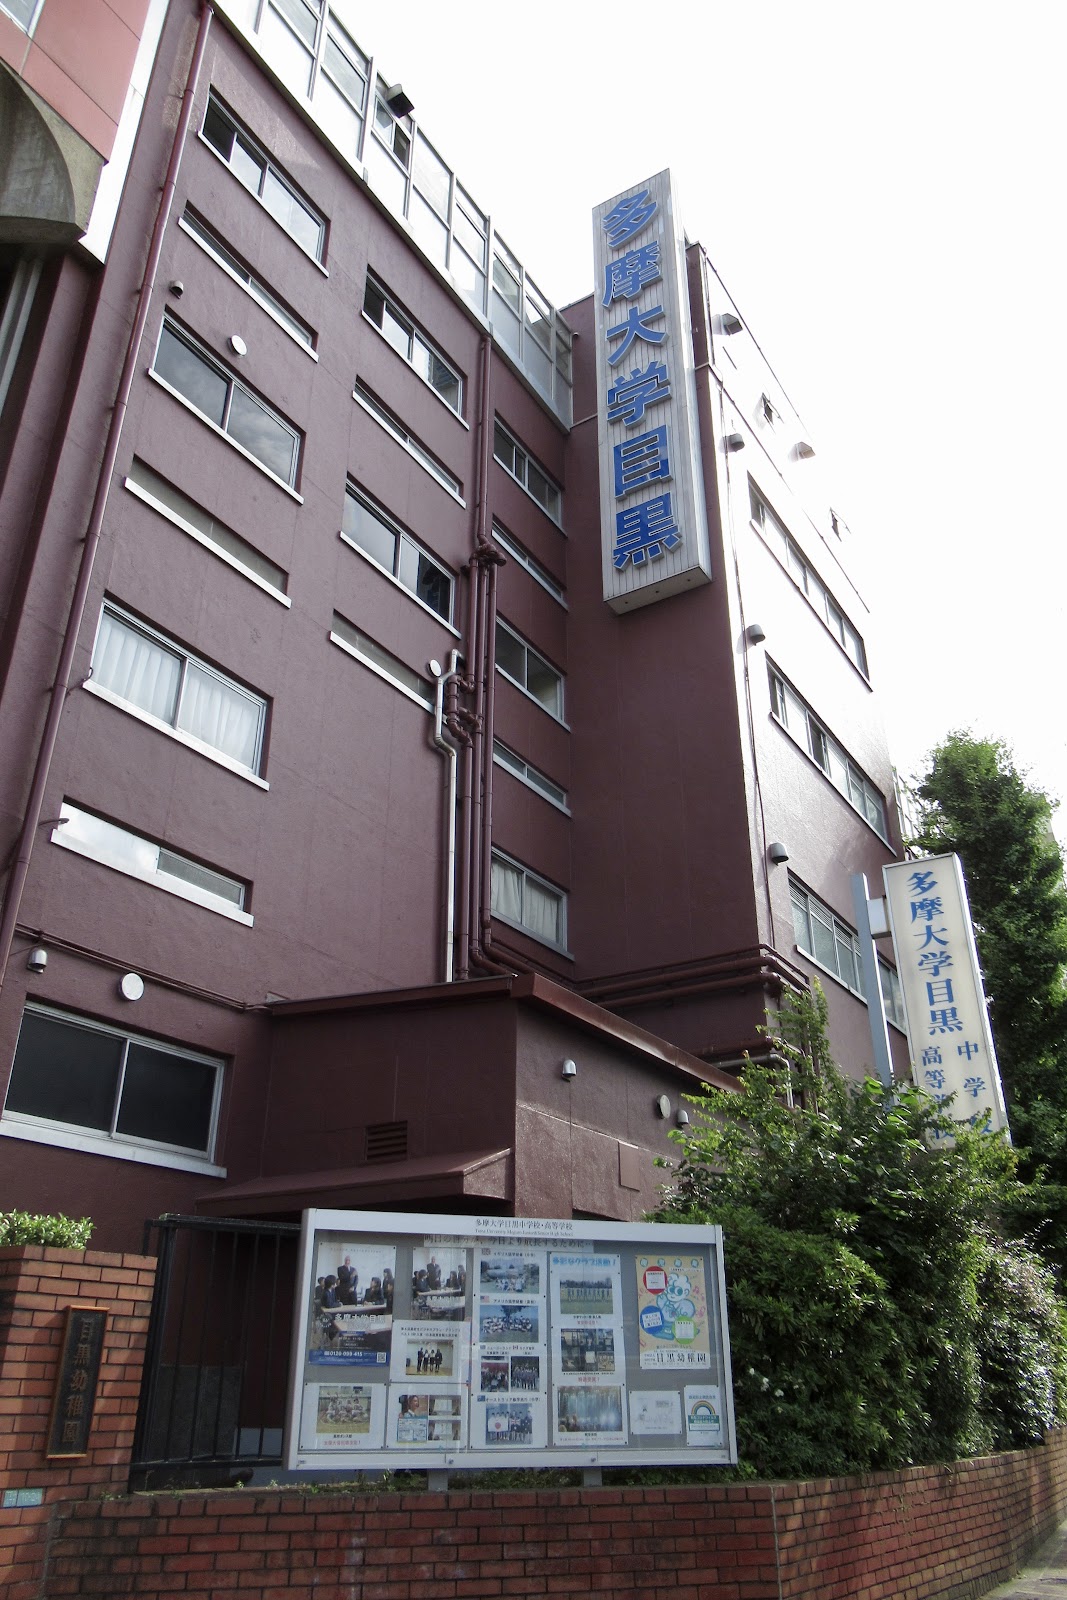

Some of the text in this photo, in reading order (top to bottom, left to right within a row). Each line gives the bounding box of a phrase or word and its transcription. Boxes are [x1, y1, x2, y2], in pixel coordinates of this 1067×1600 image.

[602, 189, 683, 573] 多摩大学目黒
[907, 871, 963, 1035] 多摩大学目黒
[63, 1317, 95, 1443] 目黒幼稚園
[657, 1352, 706, 1363] 目黒幼稚園
